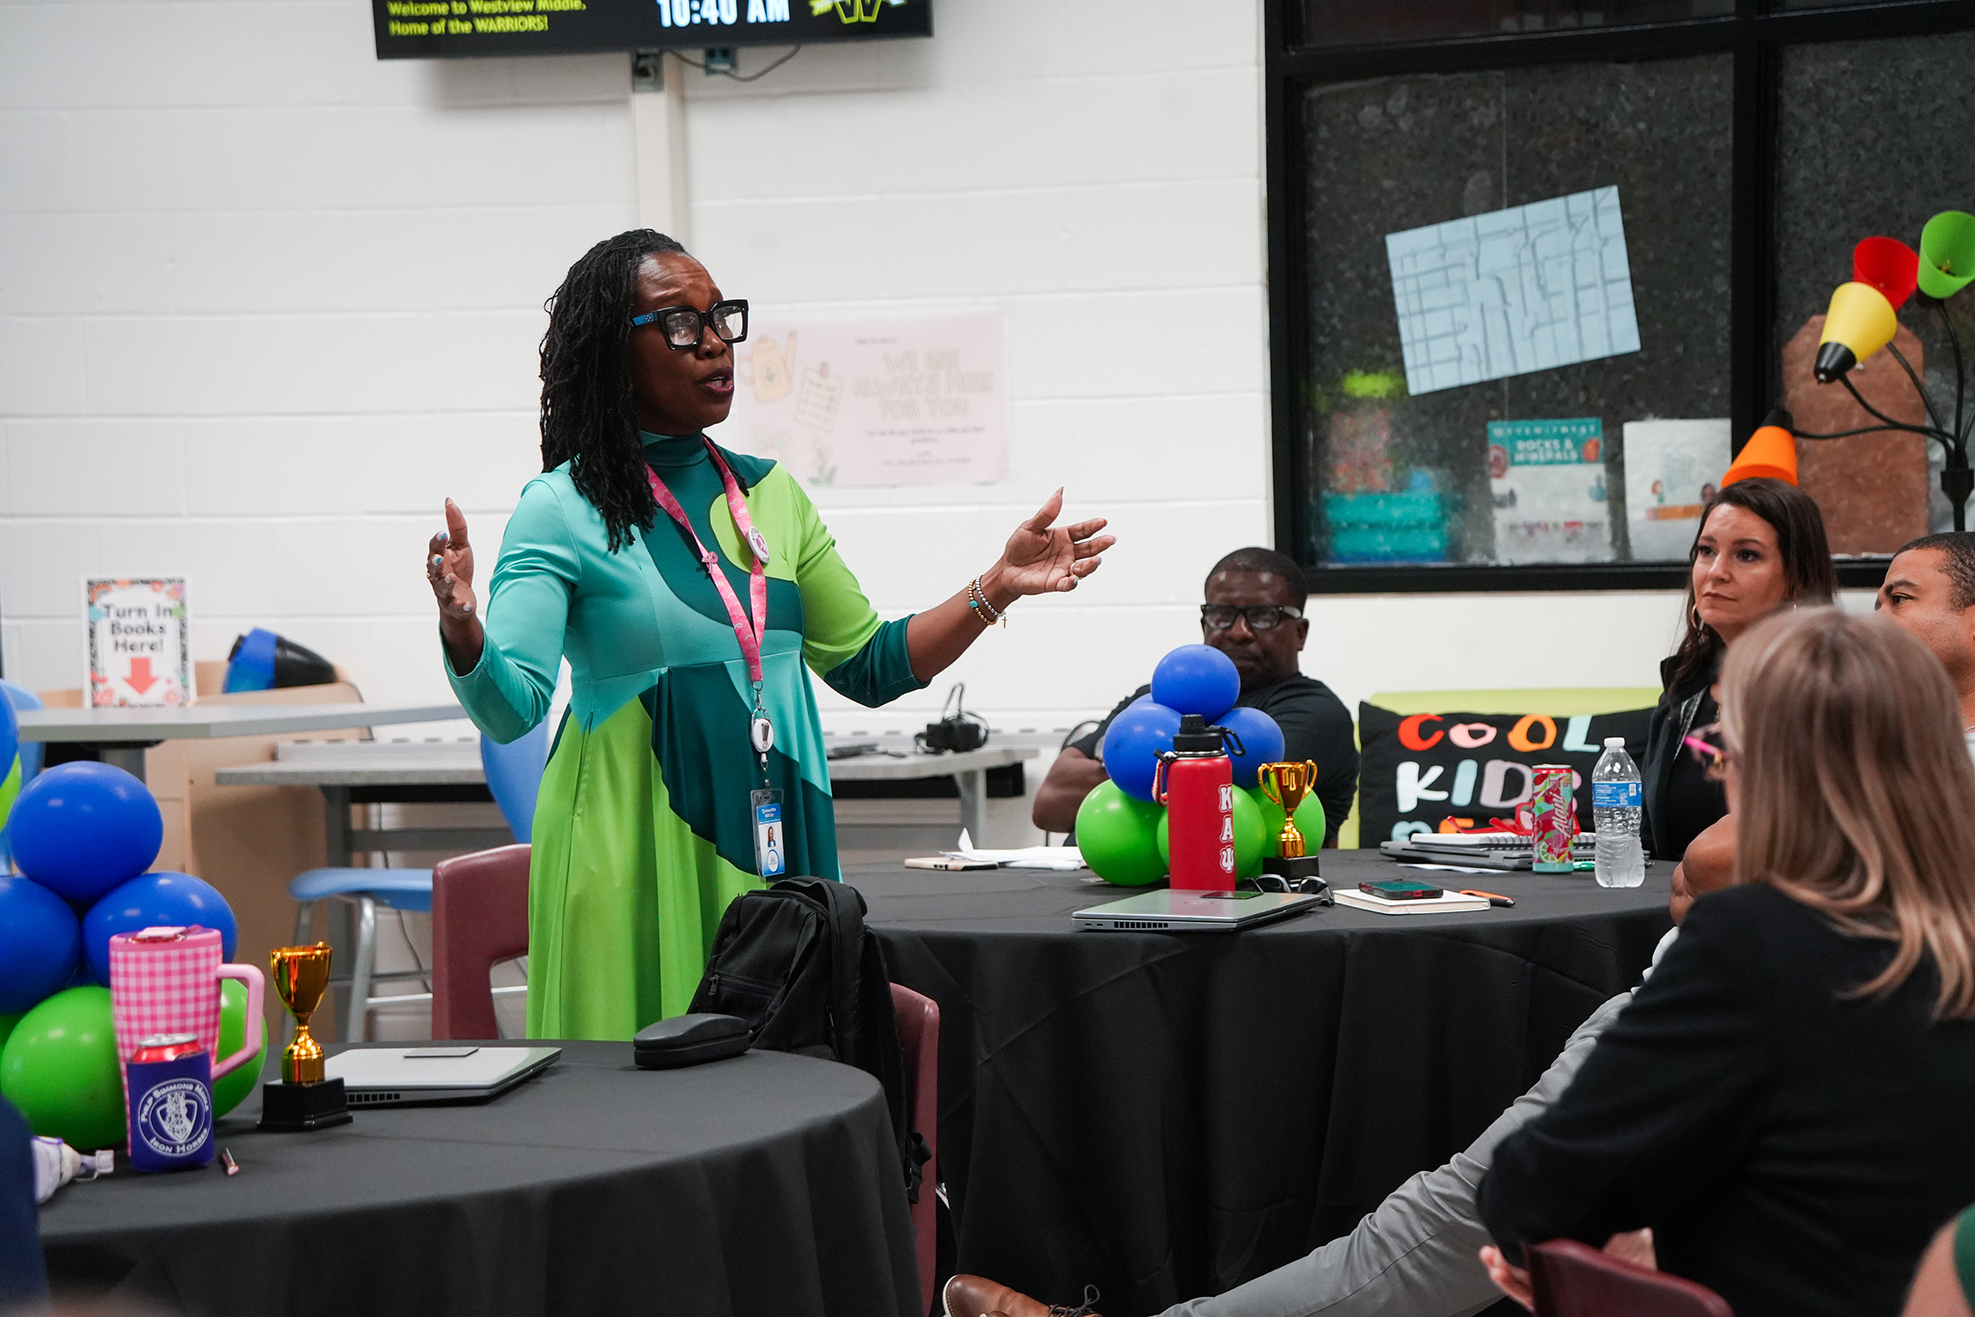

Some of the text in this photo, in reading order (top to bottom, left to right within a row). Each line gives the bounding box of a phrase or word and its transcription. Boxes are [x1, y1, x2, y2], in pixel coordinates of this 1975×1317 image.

[387, 0, 449, 16] Welcome
[451, 1, 467, 15] to
[469, 0, 535, 14] Westview
[657, 0, 738, 27] 10:40
[746, 0, 790, 23] AM
[389, 15, 548, 36] Home of the WARRIORS!
[884, 350, 960, 372] WE ARE
[854, 371, 995, 397] ALWAYS HERE
[880, 397, 970, 420] FOR YOU
[1516, 439, 1561, 451] ROCKS
[103, 603, 173, 618] Turn In
[111, 621, 166, 634] Books
[114, 639, 164, 652] Here!
[1398, 714, 1600, 751] COOL
[1552, 792, 1571, 839] Alani
[150, 1137, 173, 1153] IRON
